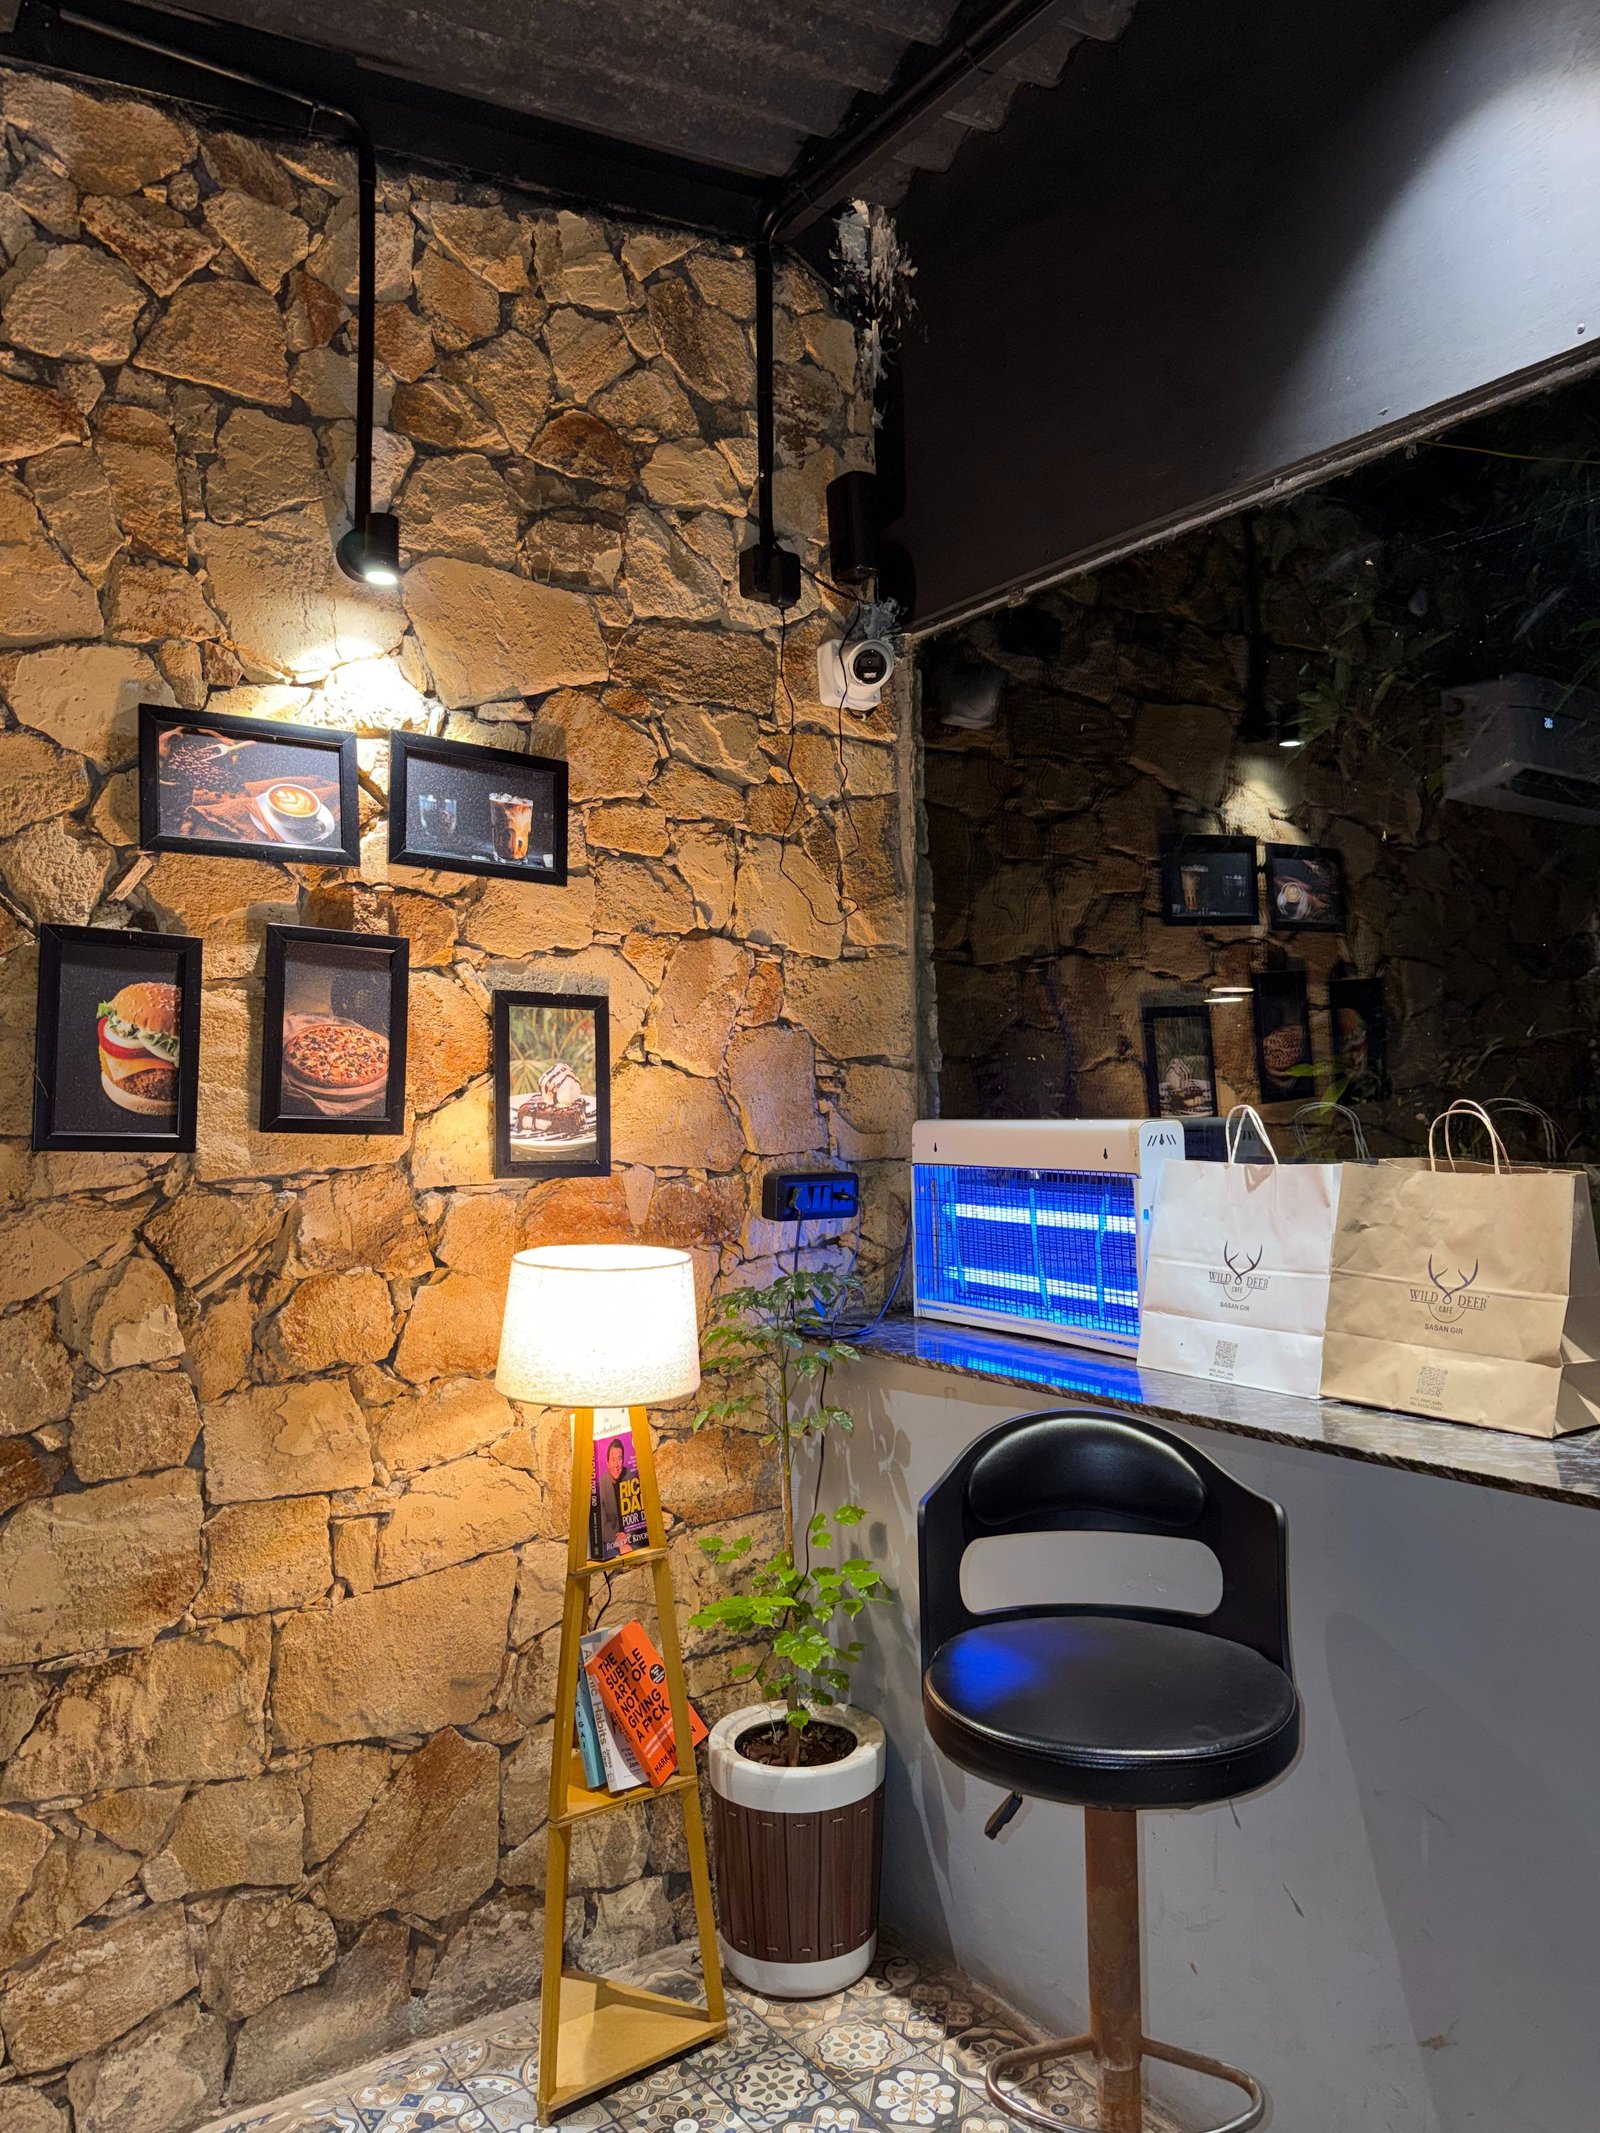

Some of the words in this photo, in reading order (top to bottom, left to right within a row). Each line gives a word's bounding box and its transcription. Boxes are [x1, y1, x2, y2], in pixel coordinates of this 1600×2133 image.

[1208, 1271, 1231, 1284] WILD
[1246, 1276, 1269, 1289] DEER
[1219, 1302, 1239, 1310] SASAN
[1409, 1289, 1438, 1303] WILD
[1457, 1295, 1487, 1309] DEER
[1424, 1323, 1449, 1333] SASAN
[1450, 1327, 1463, 1335] GIR
[619, 1477, 642, 1499] RIC
[620, 1493, 644, 1517] DA
[622, 1512, 639, 1527] POOR
[598, 1652, 617, 1676] THE
[606, 1647, 643, 1690] SUBTLE
[614, 1677, 632, 1704] ART
[631, 1660, 647, 1682] OF
[620, 1688, 640, 1717] NOT
[628, 1688, 662, 1729] GIVING
[593, 1701, 607, 1745] Habits
[635, 1729, 645, 1743] A
[654, 1753, 670, 1774] MARK
